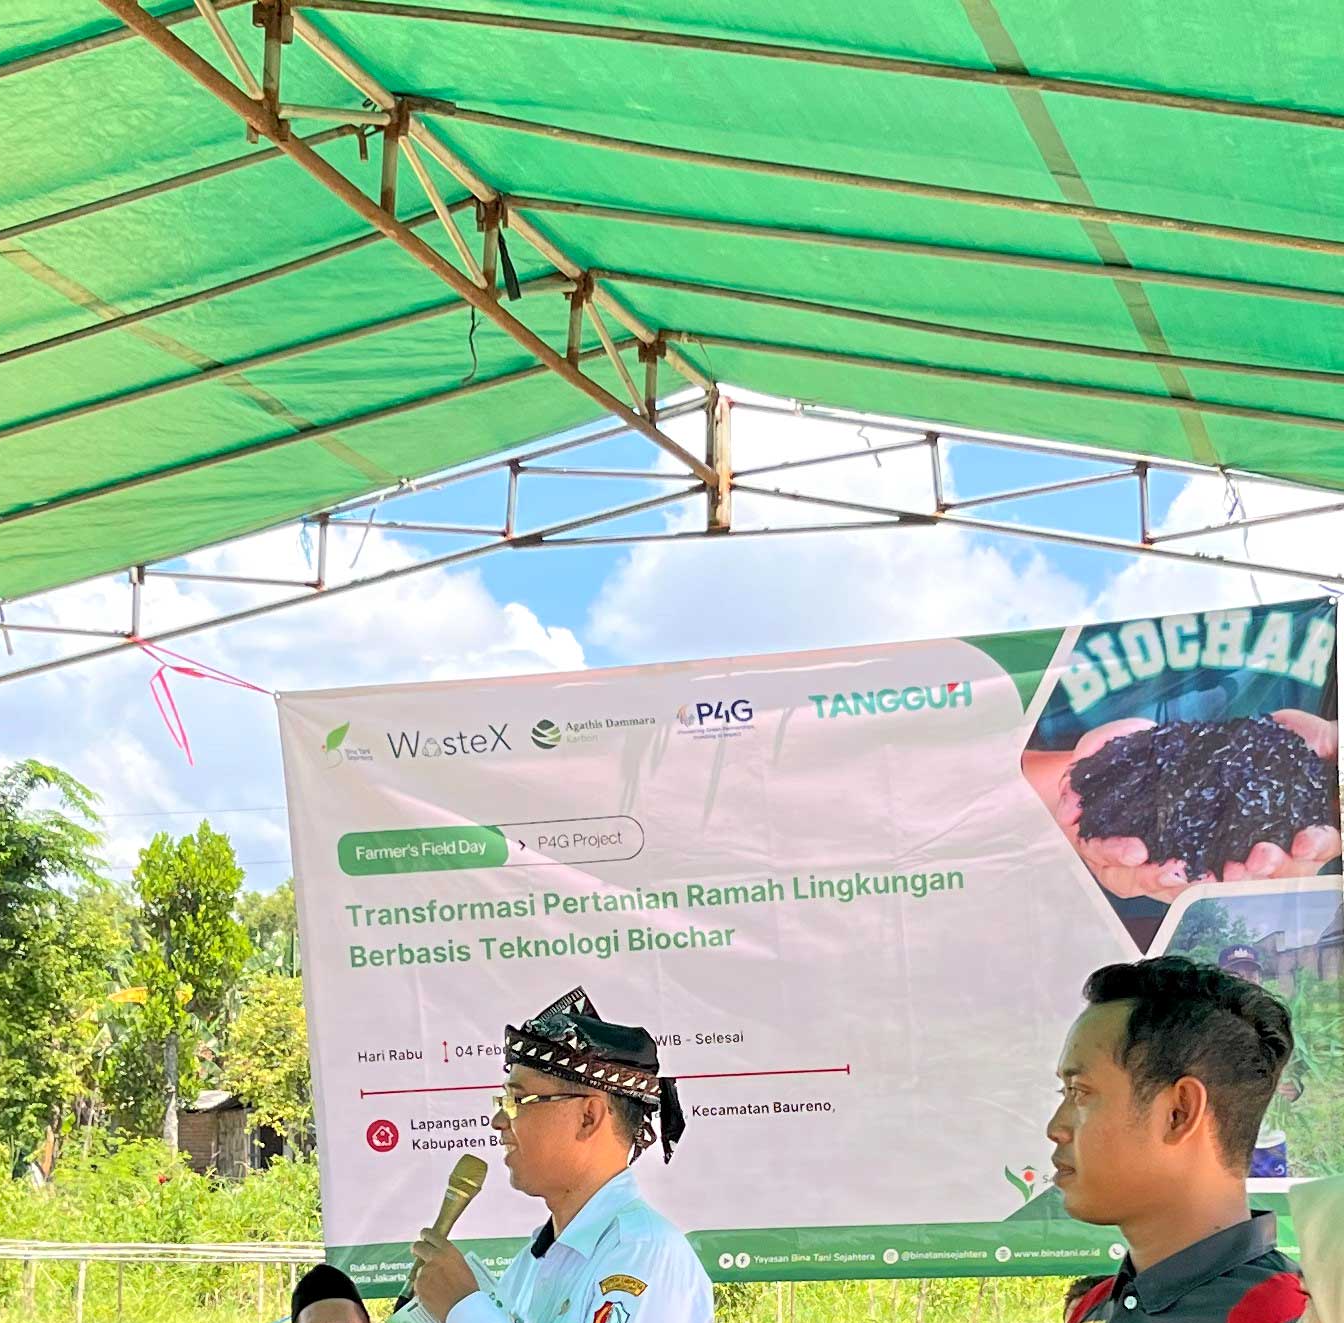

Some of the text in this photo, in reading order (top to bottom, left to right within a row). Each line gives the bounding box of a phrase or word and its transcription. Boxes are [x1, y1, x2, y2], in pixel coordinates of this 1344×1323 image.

[1057, 609, 1335, 714] BIOCHAR
[808, 681, 972, 720] TANGGUH
[696, 699, 753, 725] P4G
[565, 716, 656, 732] Agathis Dammara
[387, 723, 512, 759] WasteX
[538, 831, 623, 849] P4G Project
[355, 839, 486, 861] Farmer's Field Day
[345, 870, 964, 927] Transformasi Pertanian Ramah Lingkungan
[349, 926, 735, 968] Berbasis Teknologi Biochar
[655, 1034, 681, 1046] WIB
[695, 1031, 744, 1045] Selesai
[358, 1048, 423, 1063] Hari Rabu
[455, 1045, 473, 1057] 04
[411, 1117, 477, 1132] Lapangan
[691, 1102, 770, 1118] Kecamatan
[773, 1099, 836, 1114] Baureno,
[412, 1137, 485, 1151] Kabupaten
[754, 1252, 875, 1265] Yayasan Bina Tani Sejahtera
[1014, 1248, 1100, 1258] www.binatani.or.id
[349, 1263, 377, 1272] Rukan
